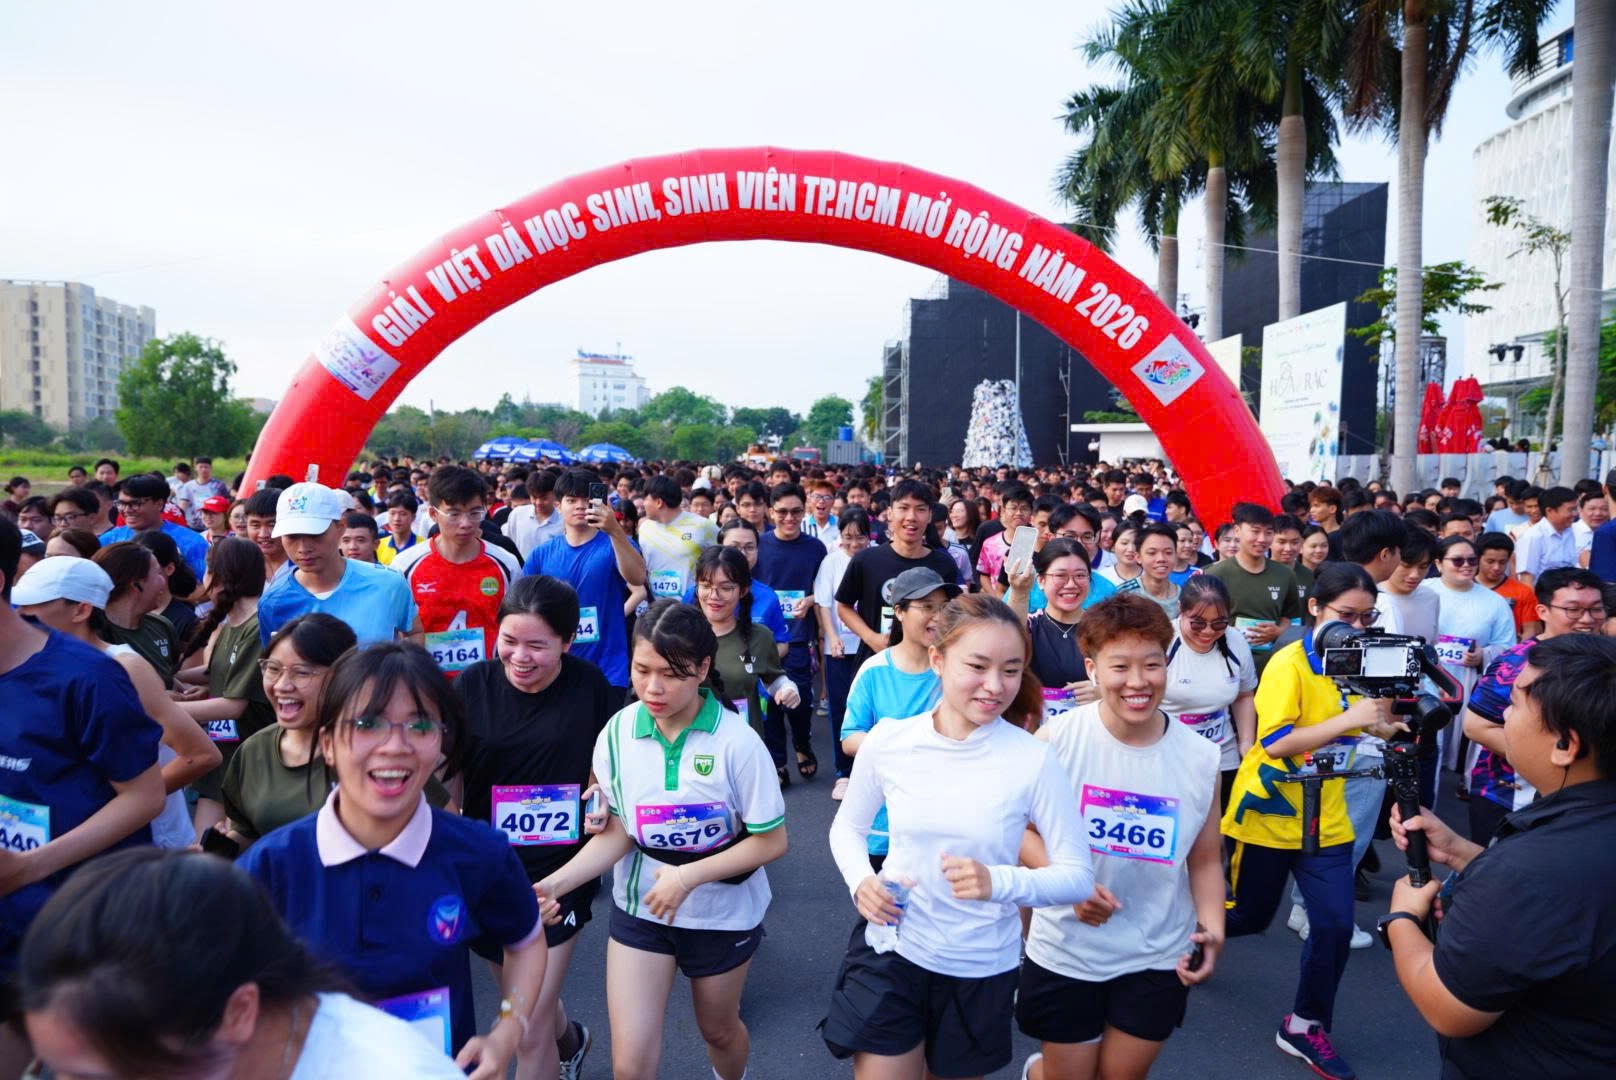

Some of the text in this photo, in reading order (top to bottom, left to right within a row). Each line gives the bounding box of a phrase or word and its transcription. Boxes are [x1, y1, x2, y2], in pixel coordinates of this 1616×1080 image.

[371, 167, 1149, 351] GIẢI VIỆT DÃ HỌC SINH, SINH VIÊN TP.HCM MỞ RỘNG NĂM 2026
[653, 582, 678, 591] 1479
[433, 648, 479, 664] 5164
[739, 655, 757, 663] VU
[501, 812, 570, 833] 4072
[1088, 817, 1166, 848] 3466
[649, 823, 721, 847] 3676
